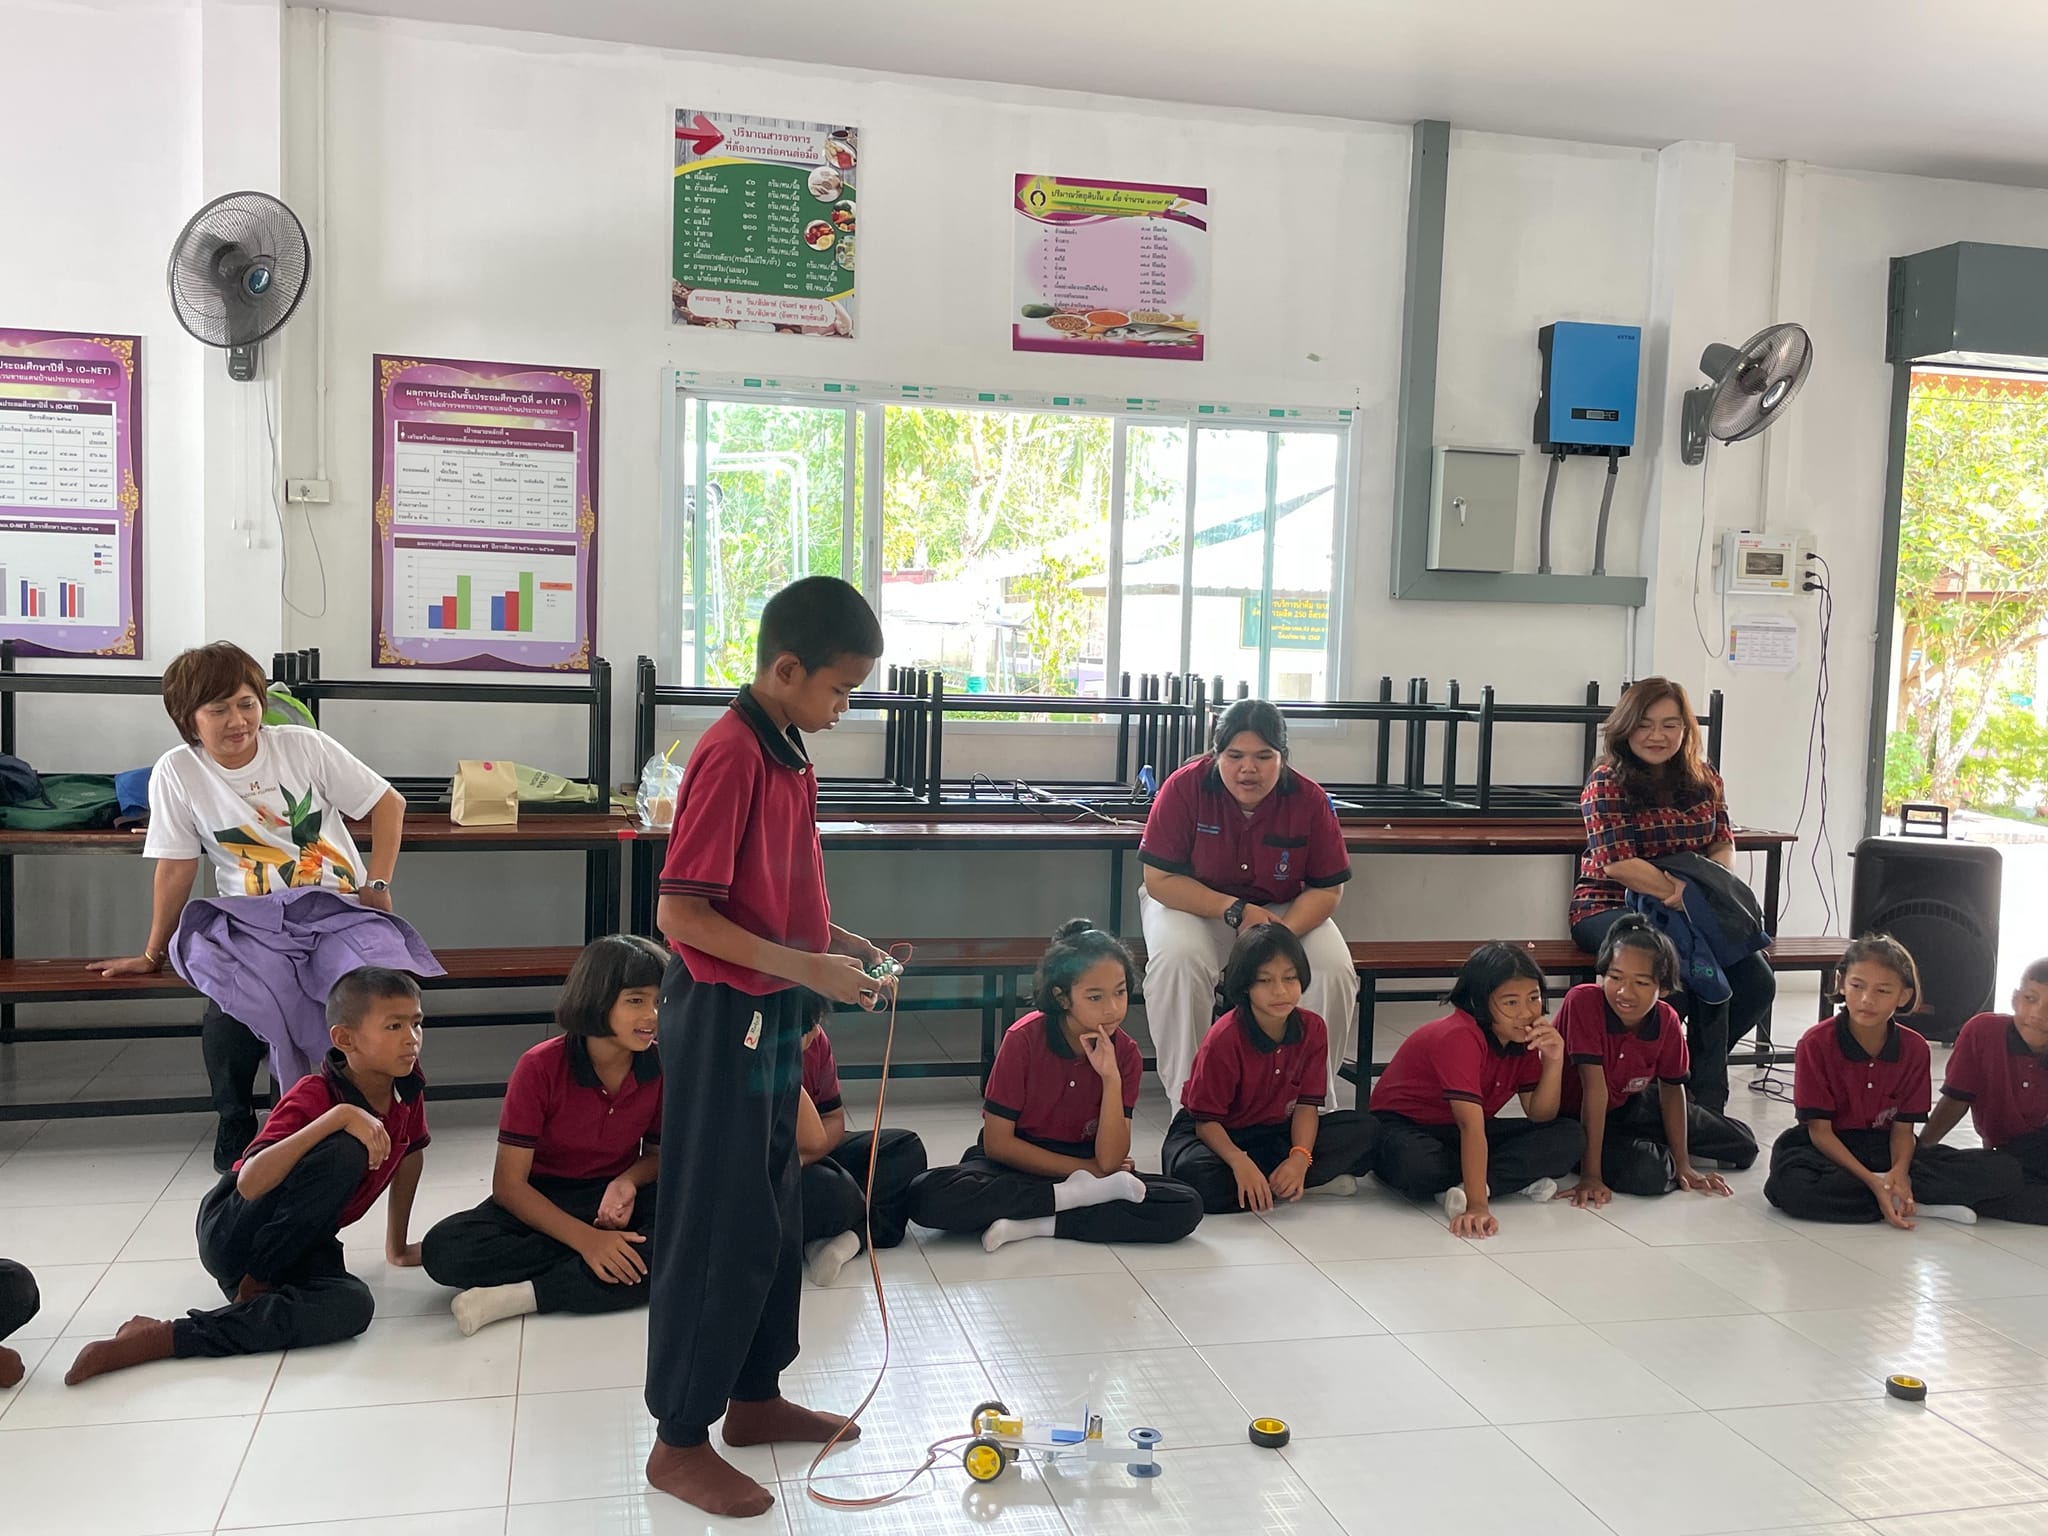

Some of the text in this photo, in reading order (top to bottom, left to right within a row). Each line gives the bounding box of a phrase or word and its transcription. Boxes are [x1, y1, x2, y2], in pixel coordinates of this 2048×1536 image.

[732, 127, 811, 144] ปริมาณสารอาหาร
